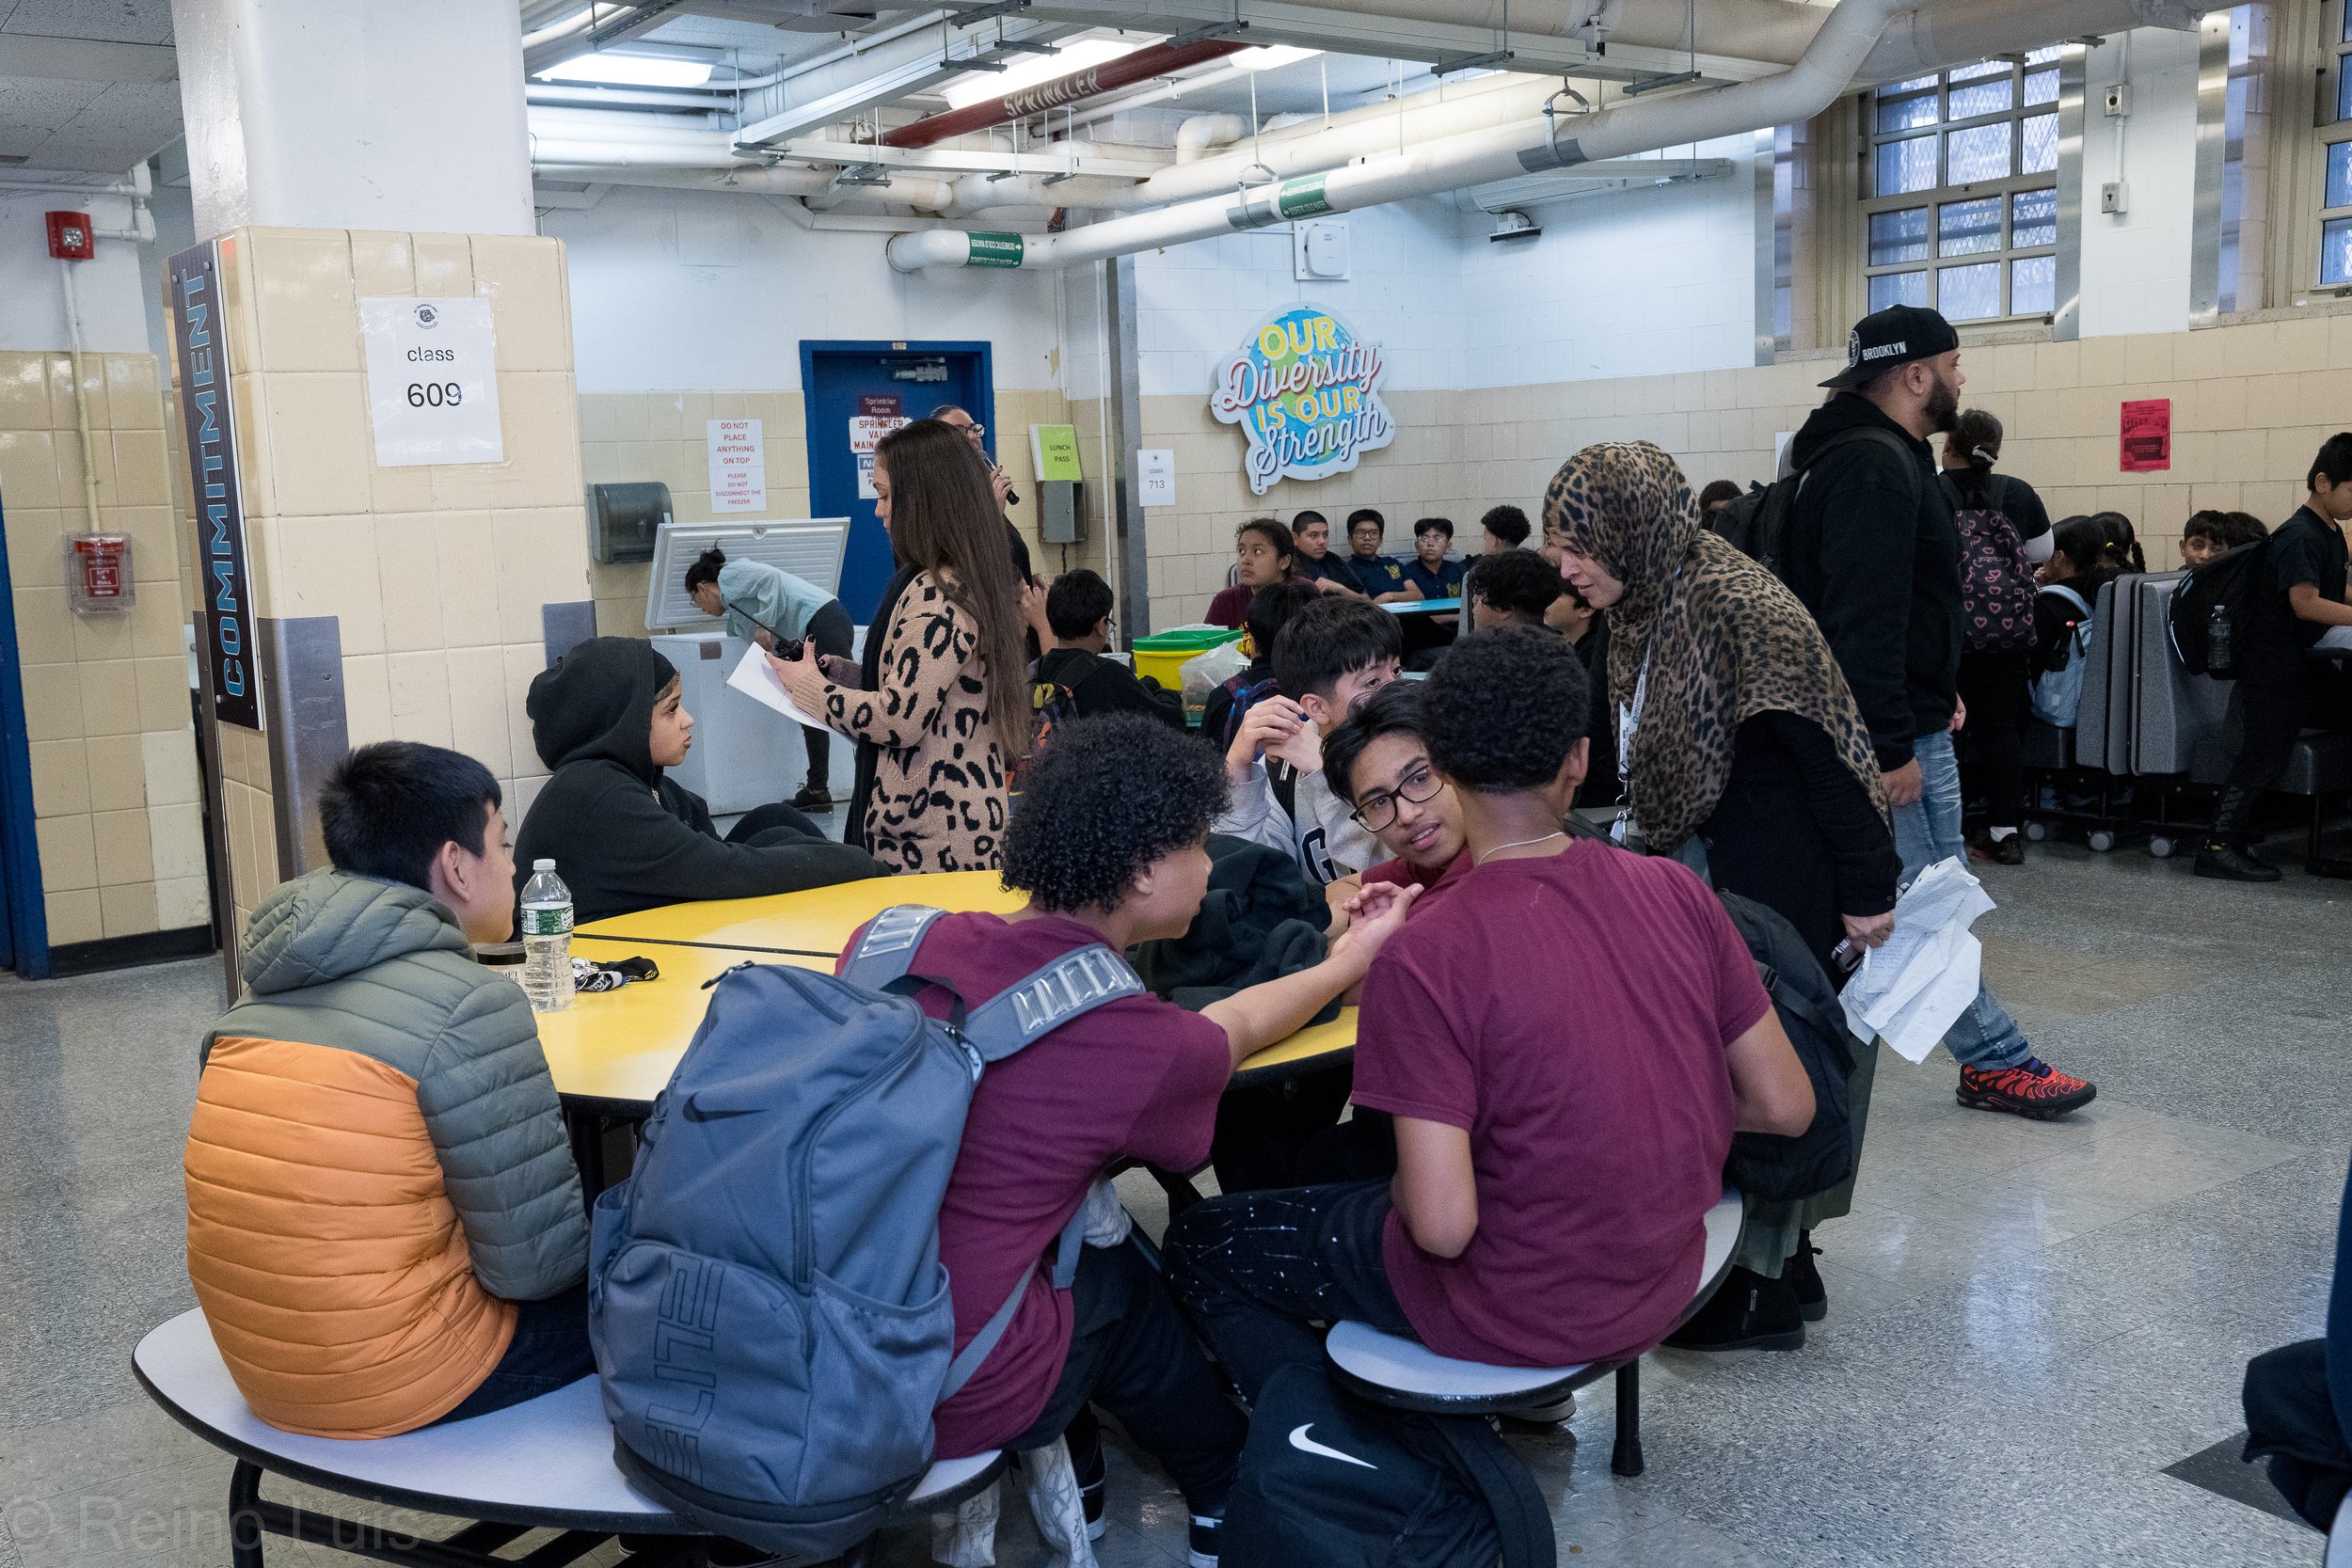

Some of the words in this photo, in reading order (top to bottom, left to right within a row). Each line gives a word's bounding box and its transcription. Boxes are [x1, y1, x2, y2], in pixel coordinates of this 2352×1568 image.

[1004, 68, 1104, 117] SPRINKLER
[1258, 316, 1337, 359] OUR
[407, 346, 454, 362] class
[1862, 341, 1908, 361] BROOKLYN
[1220, 339, 1382, 411] Diversity
[407, 382, 462, 407] 609
[865, 397, 897, 405] Sprinkler
[1256, 402, 1286, 433] IS
[1295, 386, 1360, 422] OUR
[859, 420, 904, 429] SPRINKLER
[868, 431, 890, 439] VALV
[1253, 402, 1388, 485] Strength
[182, 268, 246, 697] COMMITMENT
[1148, 480, 1166, 489] 713
